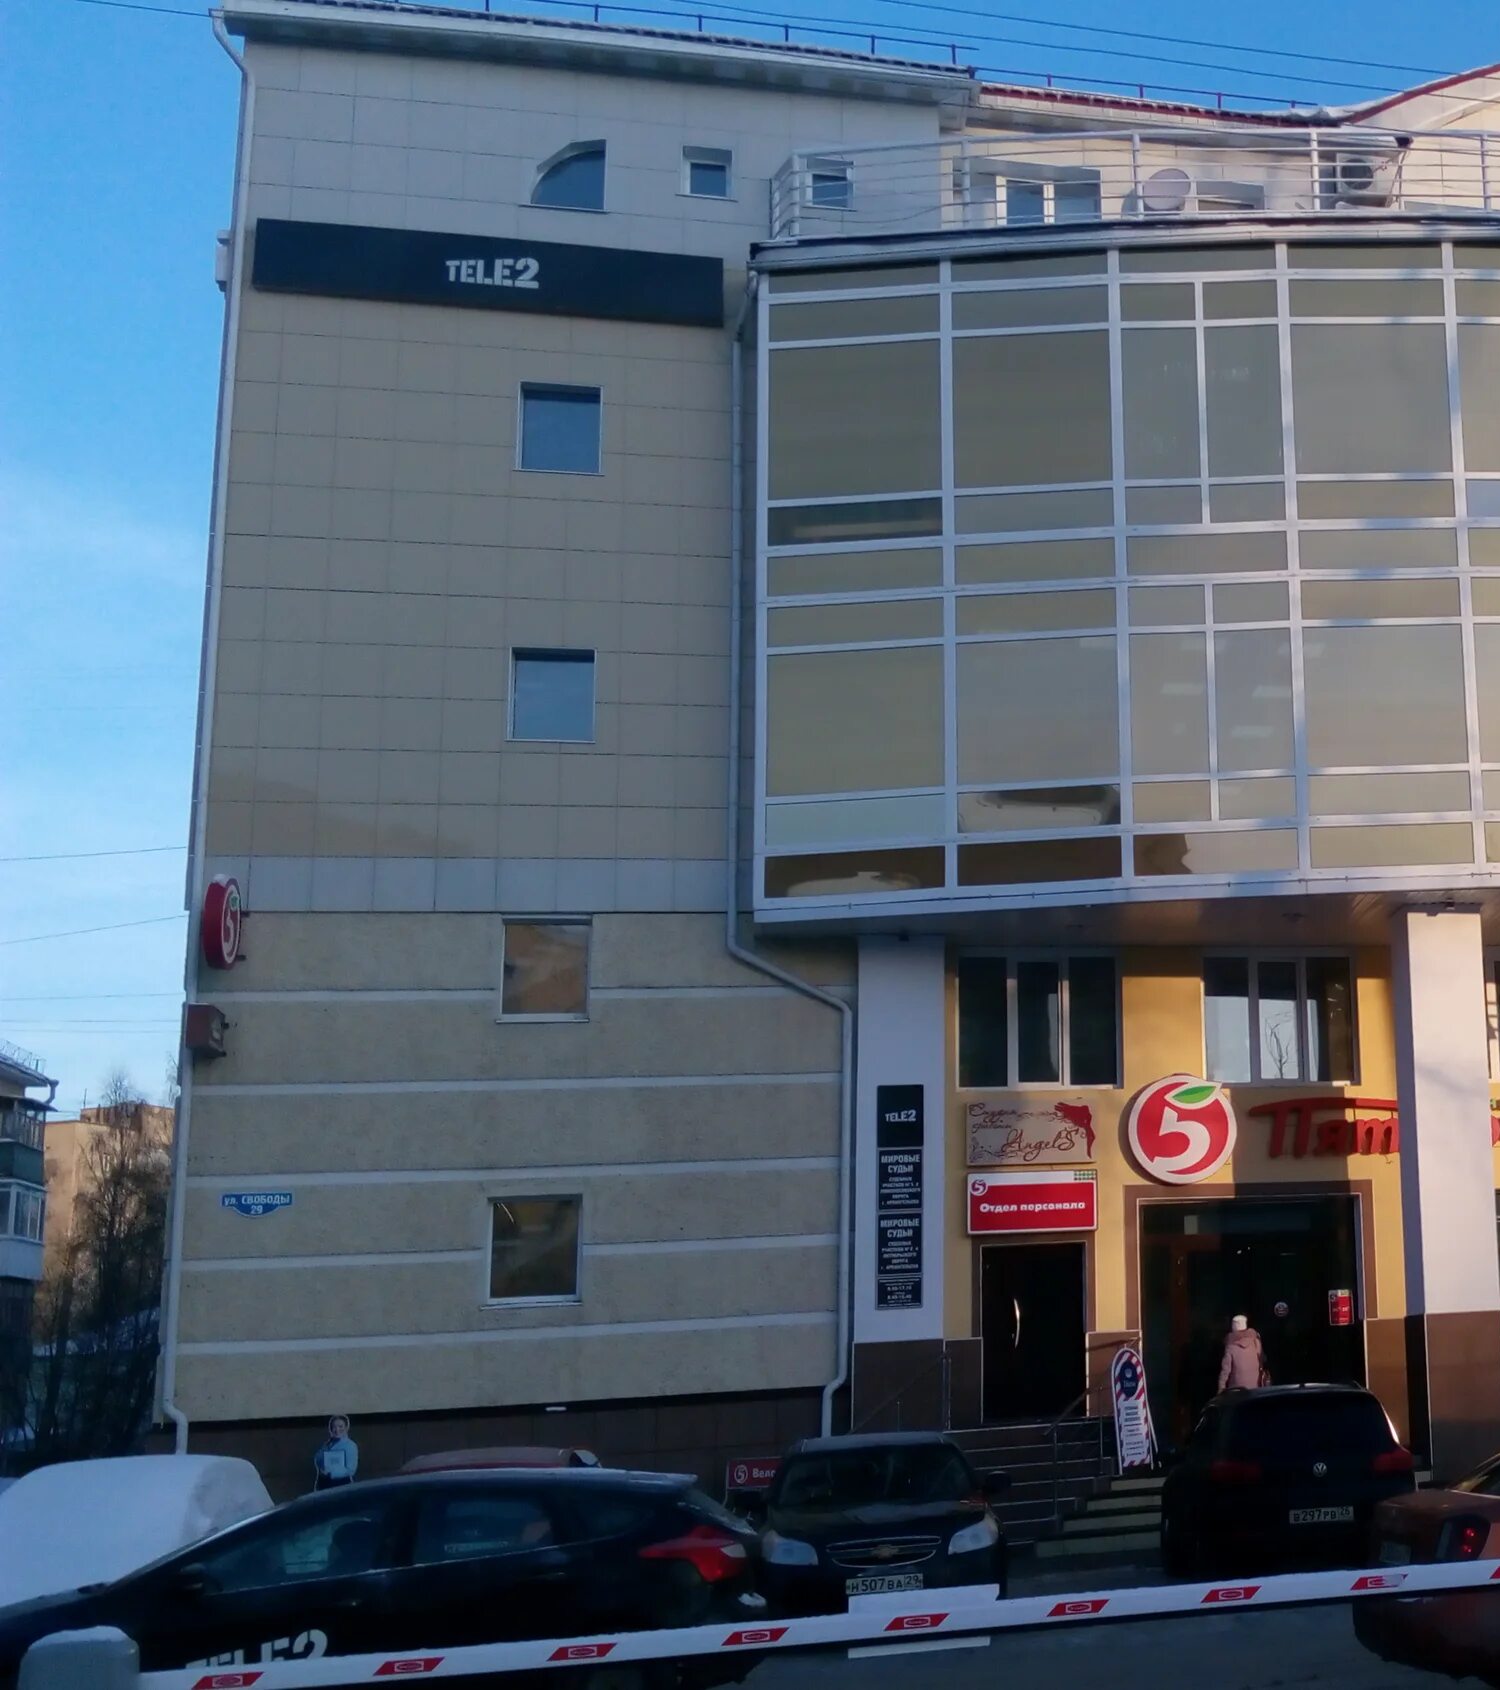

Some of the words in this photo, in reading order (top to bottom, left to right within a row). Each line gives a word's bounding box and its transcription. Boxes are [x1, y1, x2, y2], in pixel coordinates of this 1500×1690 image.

[445, 257, 539, 289] TELE2
[884, 1109, 917, 1122] TELE2
[224, 1197, 239, 1206] ул.
[241, 1194, 290, 1205] СВОБОДЫ
[250, 1205, 263, 1215] 29
[979, 1203, 1018, 1214] Отдел
[1020, 1201, 1086, 1213] персонала
